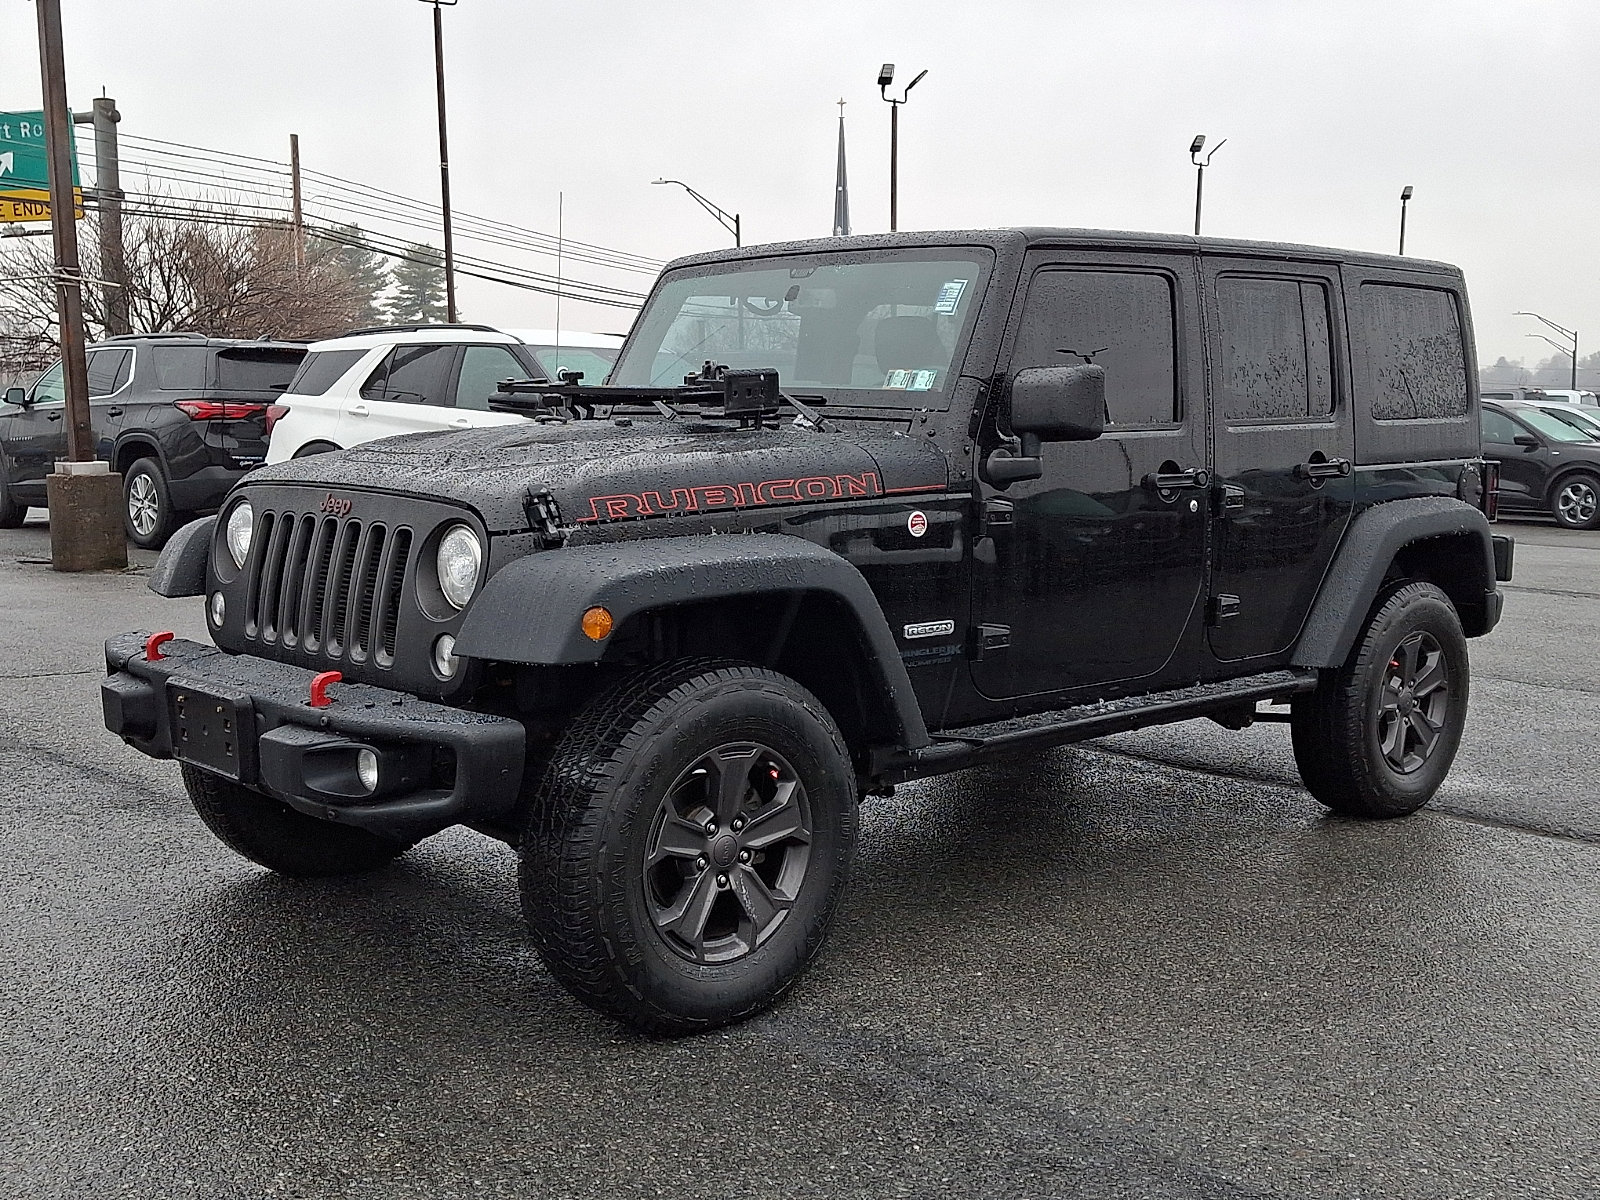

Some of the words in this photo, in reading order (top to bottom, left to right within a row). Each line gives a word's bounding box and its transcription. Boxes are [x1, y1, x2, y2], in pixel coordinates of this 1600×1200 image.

[320, 492, 352, 518] Jeep
[577, 472, 883, 521] RUBICON
[908, 623, 952, 636] RECON
